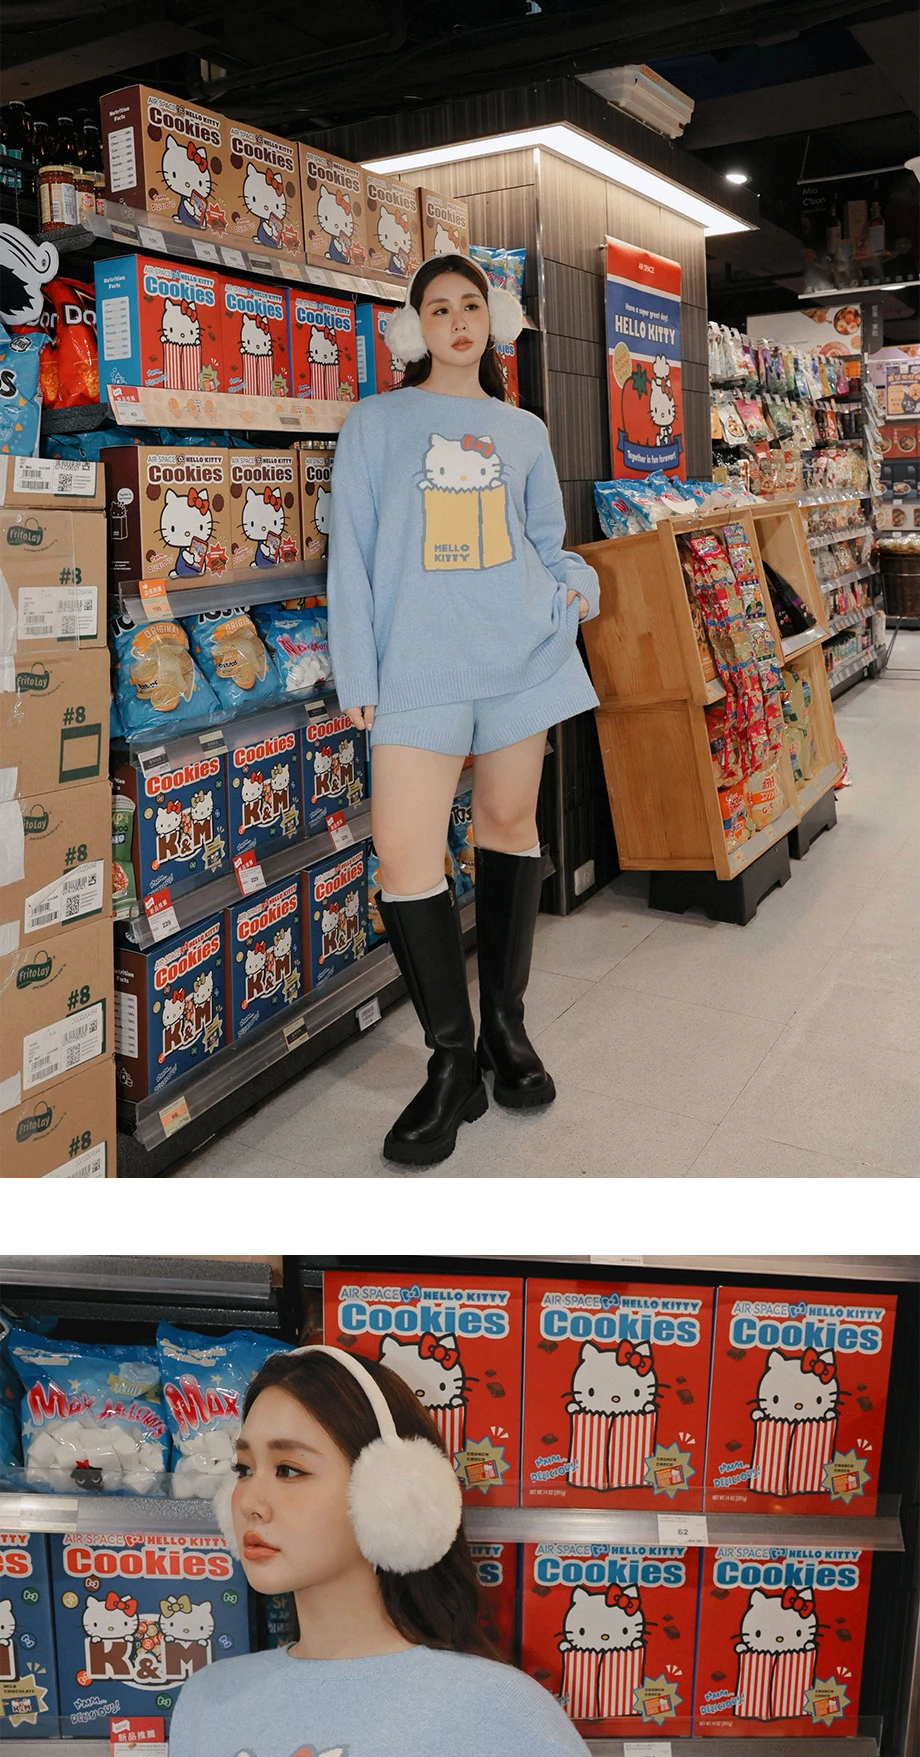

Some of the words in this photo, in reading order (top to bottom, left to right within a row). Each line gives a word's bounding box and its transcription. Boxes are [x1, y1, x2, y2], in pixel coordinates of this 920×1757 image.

[148, 97, 158, 106] AIR
[159, 100, 177, 113] SPACE
[185, 110, 202, 121] HELLO
[203, 116, 220, 128] KITTY
[149, 107, 220, 145] Cookies
[232, 138, 294, 171] Cookies
[308, 162, 360, 192] Cookies
[427, 203, 466, 227] Cookies
[145, 277, 214, 305] Cookies
[181, 274, 197, 282] HELLO
[198, 278, 213, 287] KITTY
[226, 294, 282, 318] Cookies
[615, 315, 645, 339] HELLO
[648, 323, 676, 345] KITTY
[627, 450, 646, 463] Together
[659, 451, 676, 463] forever!
[148, 464, 223, 483] Cookies
[434, 544, 469, 552] HELLO
[434, 554, 470, 562] KITTY
[63, 706, 86, 725] #8
[145, 758, 219, 795] Cookies
[155, 937, 220, 989] Cookies
[341, 1286, 361, 1300] AIR
[363, 1286, 399, 1300] SPACE
[424, 1290, 463, 1301] HELLO
[467, 1292, 507, 1303] KITTY
[544, 1295, 562, 1307] AIR
[565, 1295, 600, 1308] SPACE
[622, 1298, 659, 1310] HELLO
[662, 1300, 701, 1312] KITTY
[341, 1302, 508, 1337] Cookies
[543, 1310, 699, 1343] Cookies
[732, 1319, 882, 1352] Cookies
[65, 1534, 85, 1544] AIR
[87, 1534, 123, 1544] SPACE
[147, 1536, 186, 1546] HELLO
[190, 1537, 227, 1547] KITTY
[67, 1548, 230, 1576] Cookies
[537, 1558, 685, 1585] Cookies
